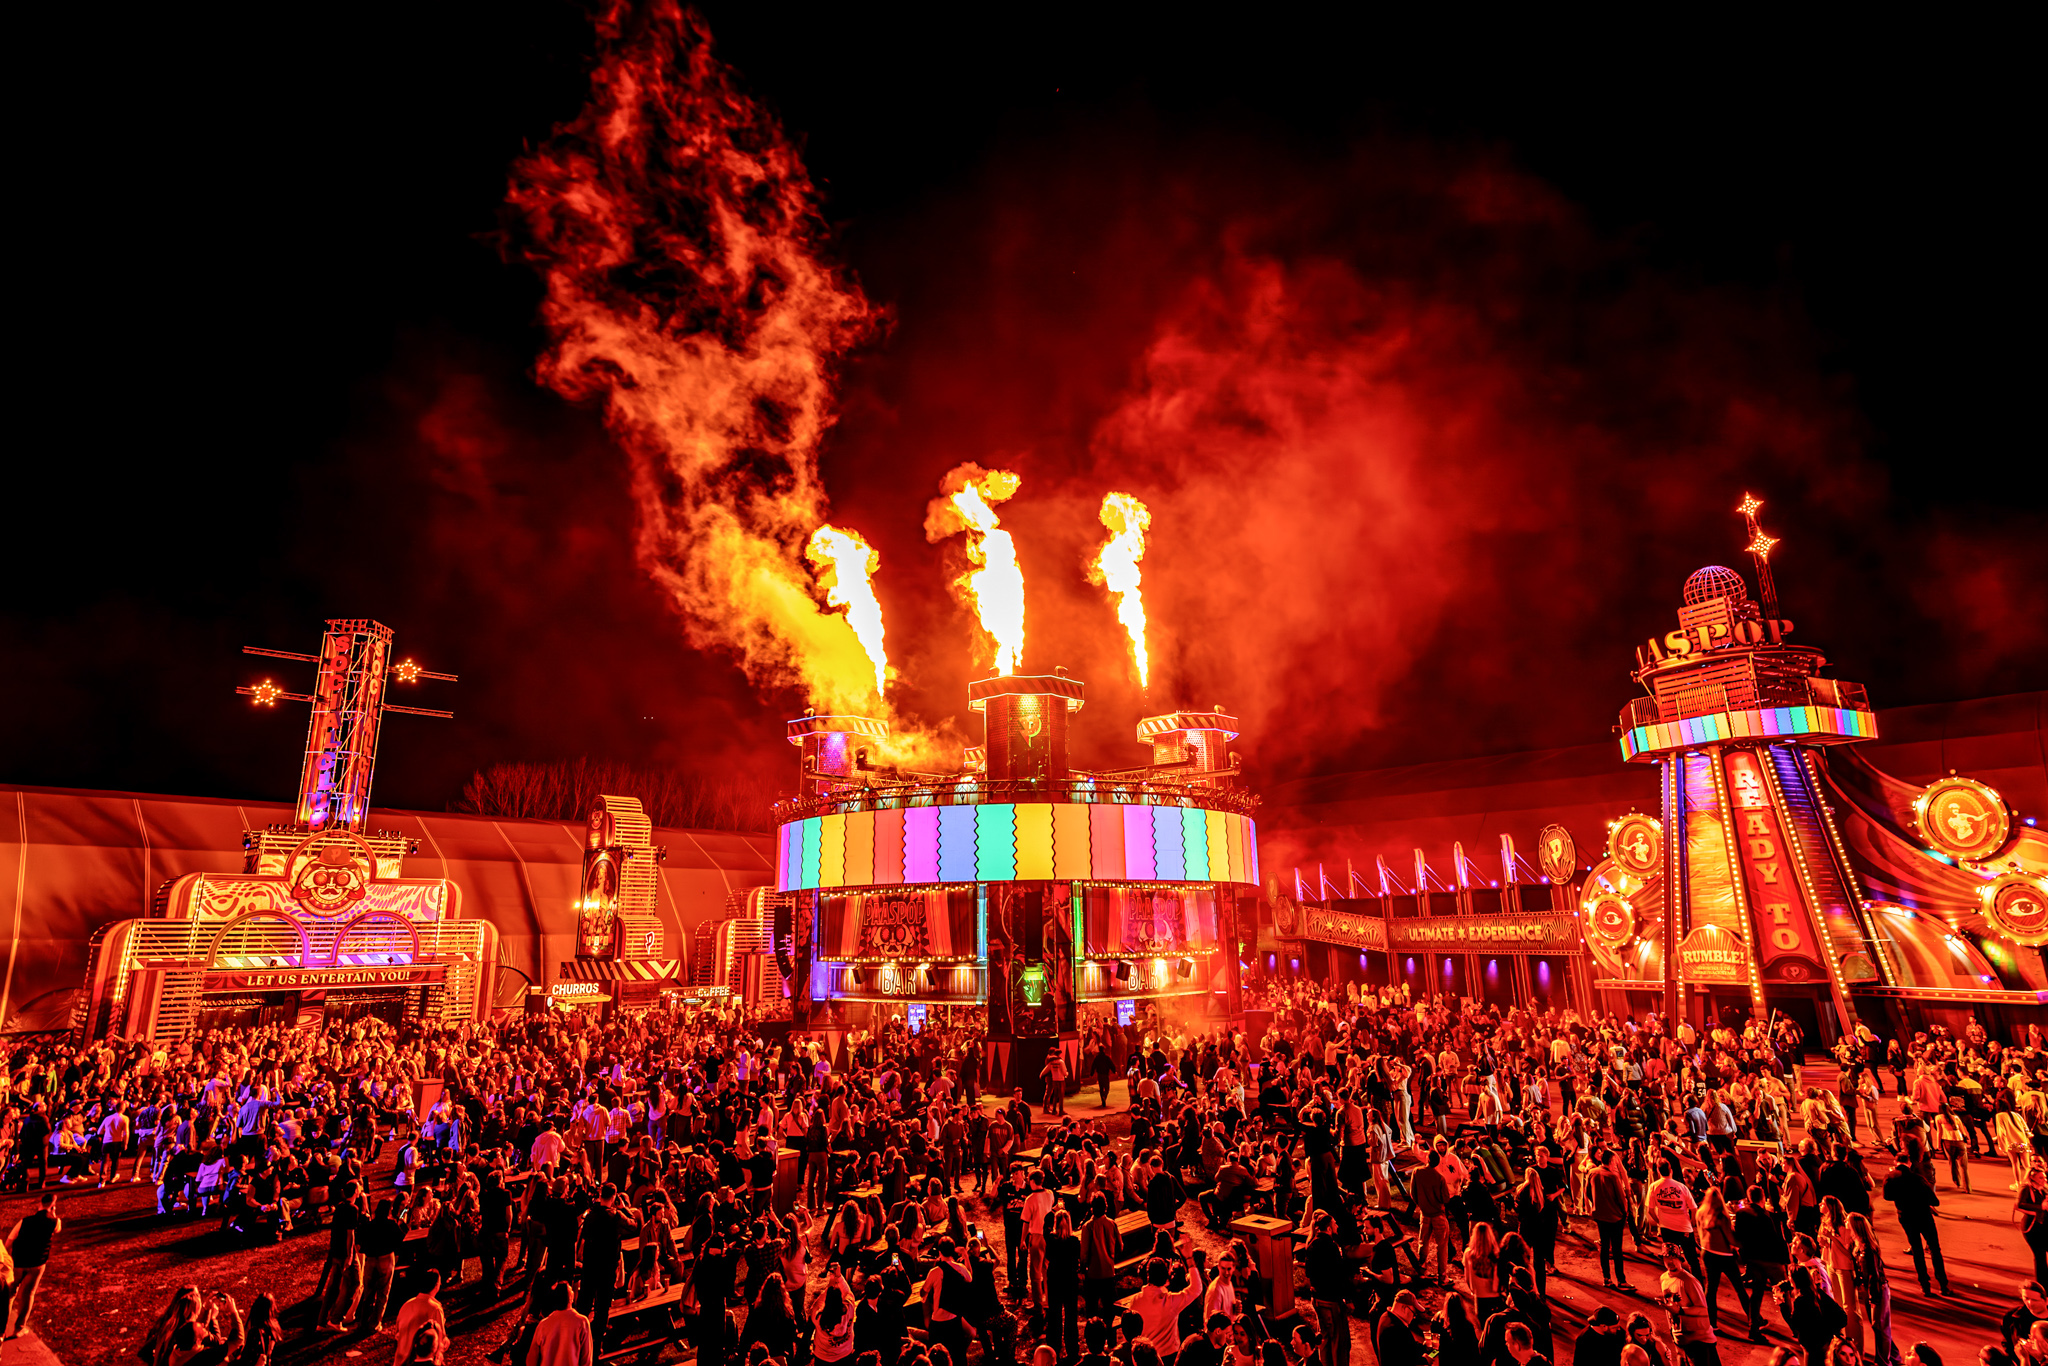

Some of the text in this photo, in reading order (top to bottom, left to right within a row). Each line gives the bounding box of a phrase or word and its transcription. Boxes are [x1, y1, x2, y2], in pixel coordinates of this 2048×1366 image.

[325, 619, 368, 633] THE
[372, 620, 394, 644] THE
[1732, 769, 1801, 951] READY TO
[864, 901, 926, 925] PAASPOP
[1129, 896, 1182, 920] PAASPOP
[1408, 925, 1544, 942] ULTIMATE EXPERIENCE
[1683, 950, 1745, 964] RUMBLE!
[247, 971, 410, 986] LET US ENTERTAIN YOU!
[882, 966, 916, 995] BAR
[1128, 962, 1158, 992] BAR
[552, 982, 600, 995] CHURROS
[697, 986, 731, 997] COFFEE
